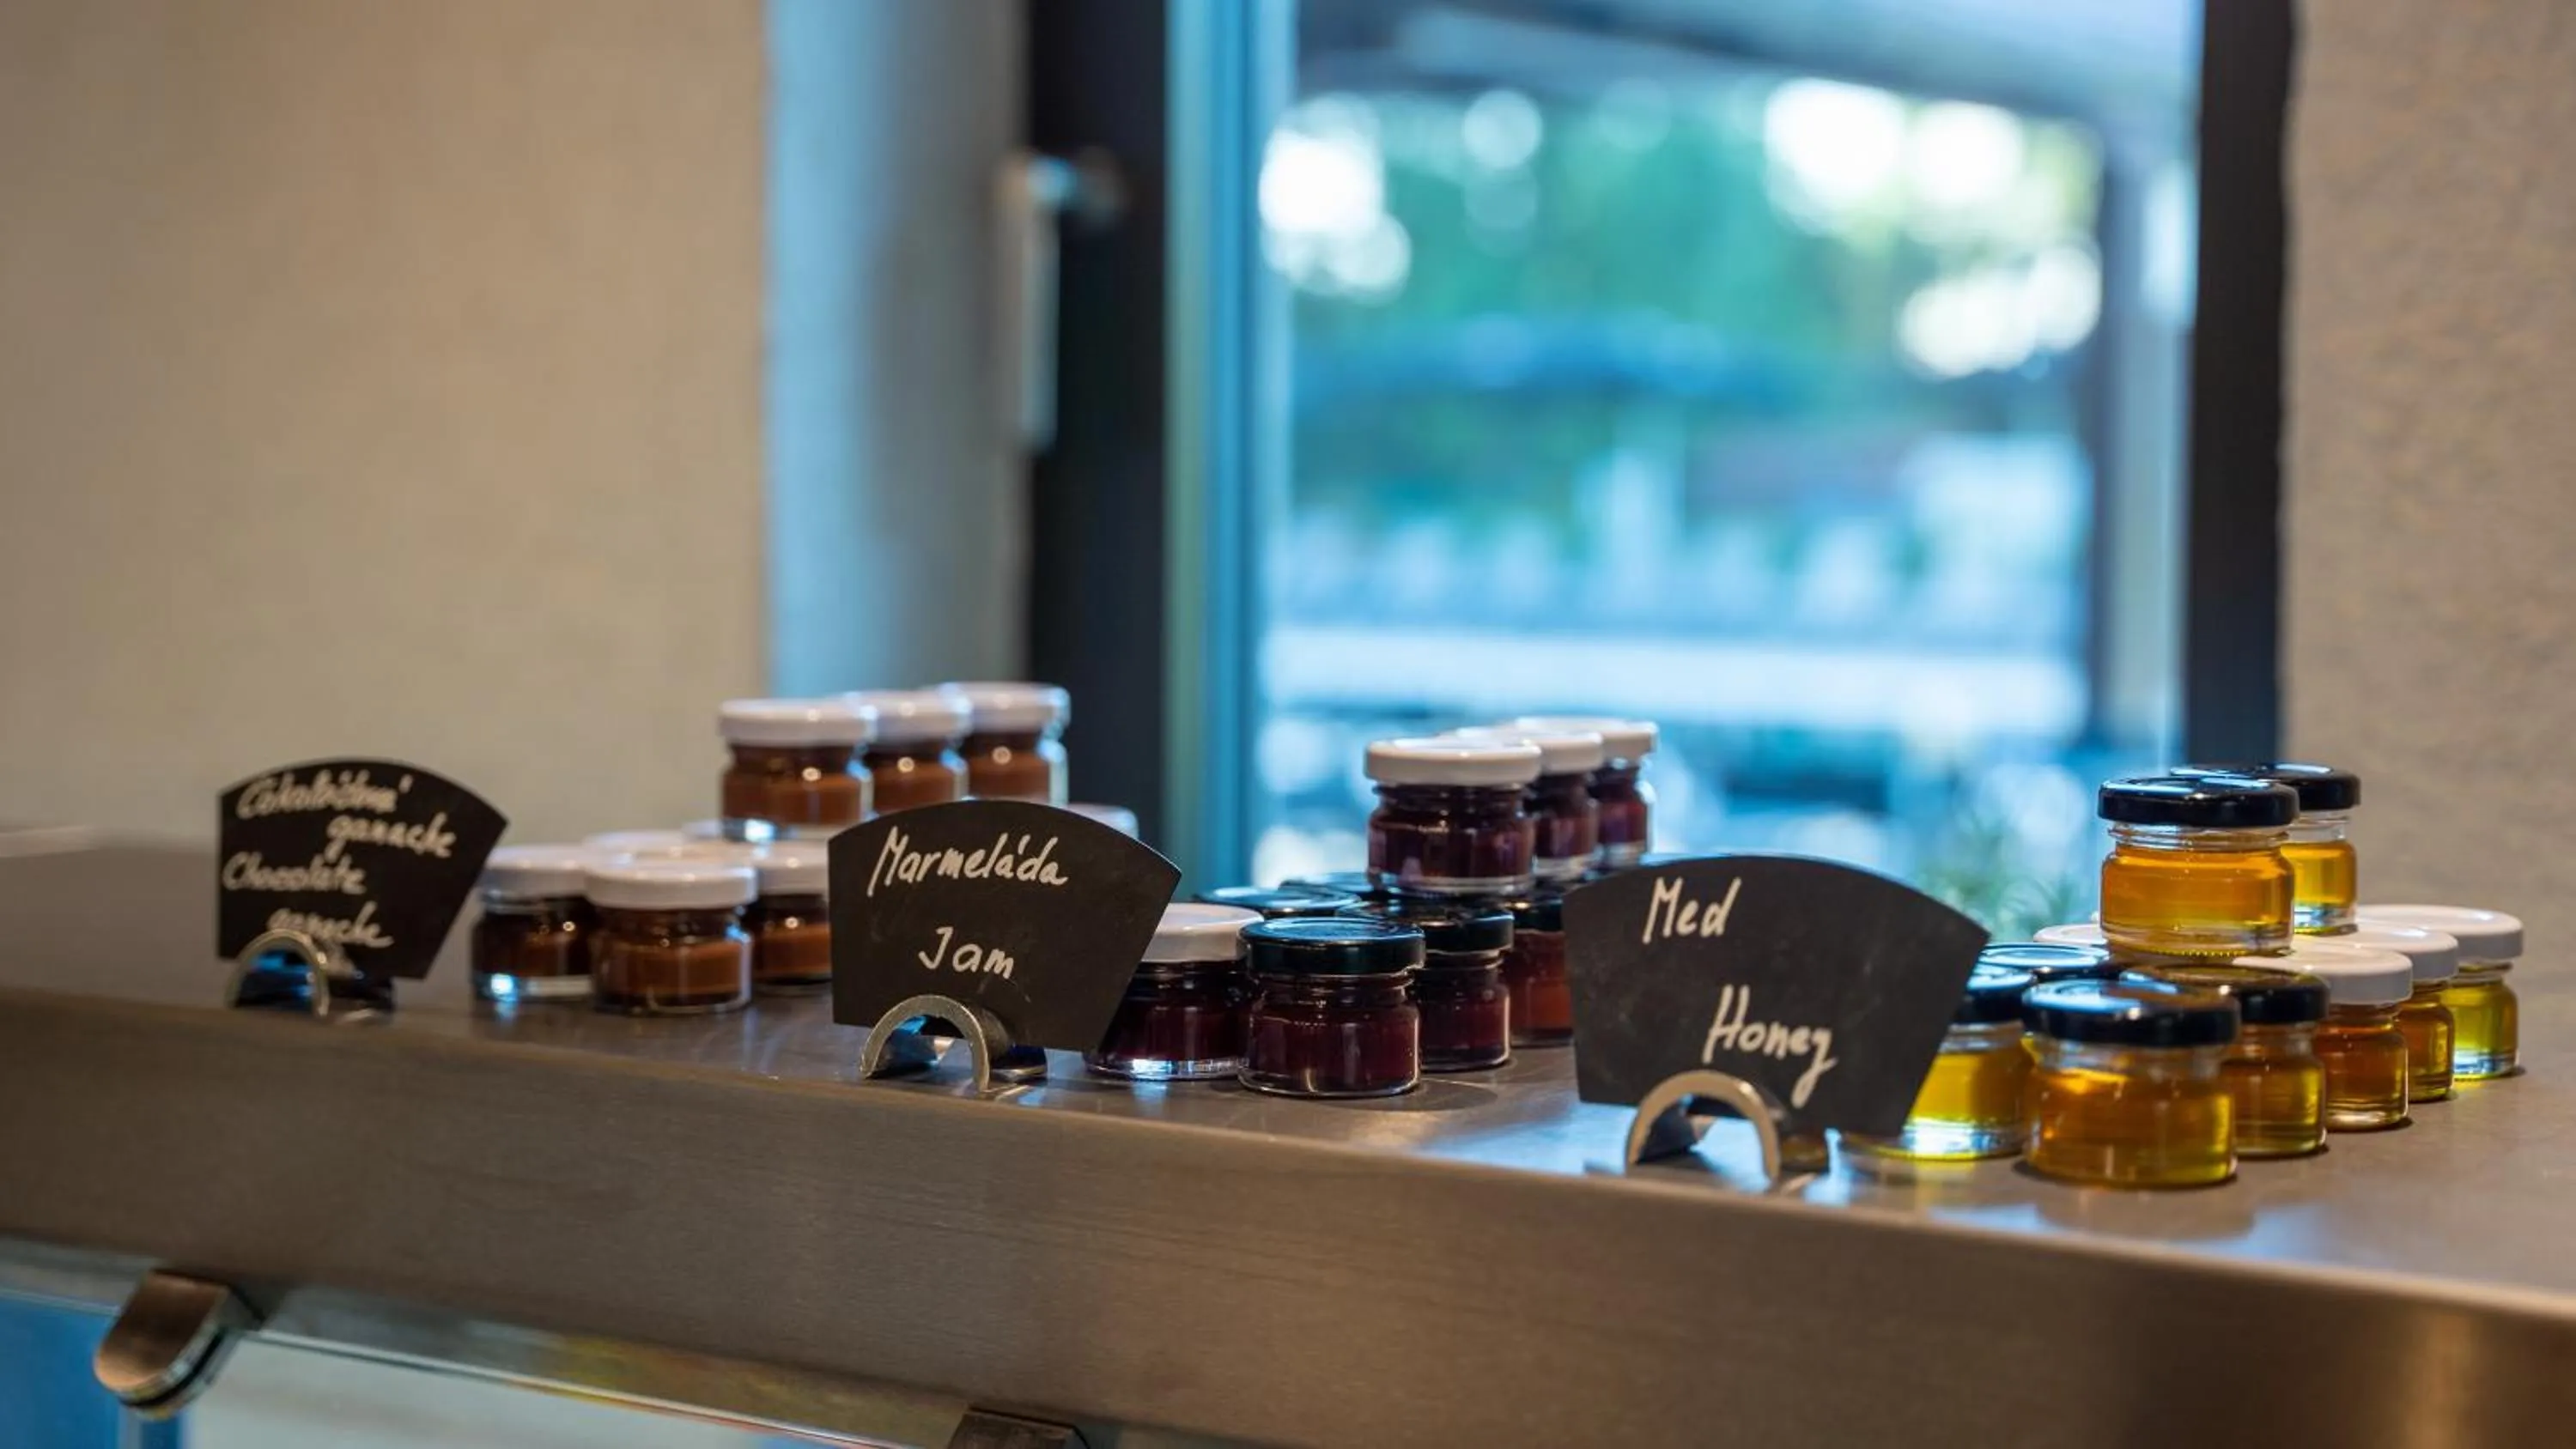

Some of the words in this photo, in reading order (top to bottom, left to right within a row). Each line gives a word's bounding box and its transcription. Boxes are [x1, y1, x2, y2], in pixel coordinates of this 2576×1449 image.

[222, 852, 366, 894] Chocolate
[867, 825, 1069, 897] Marmeláda
[1642, 876, 1742, 944] Med
[918, 926, 1015, 979] Jam
[1701, 984, 1838, 1109] Honey
